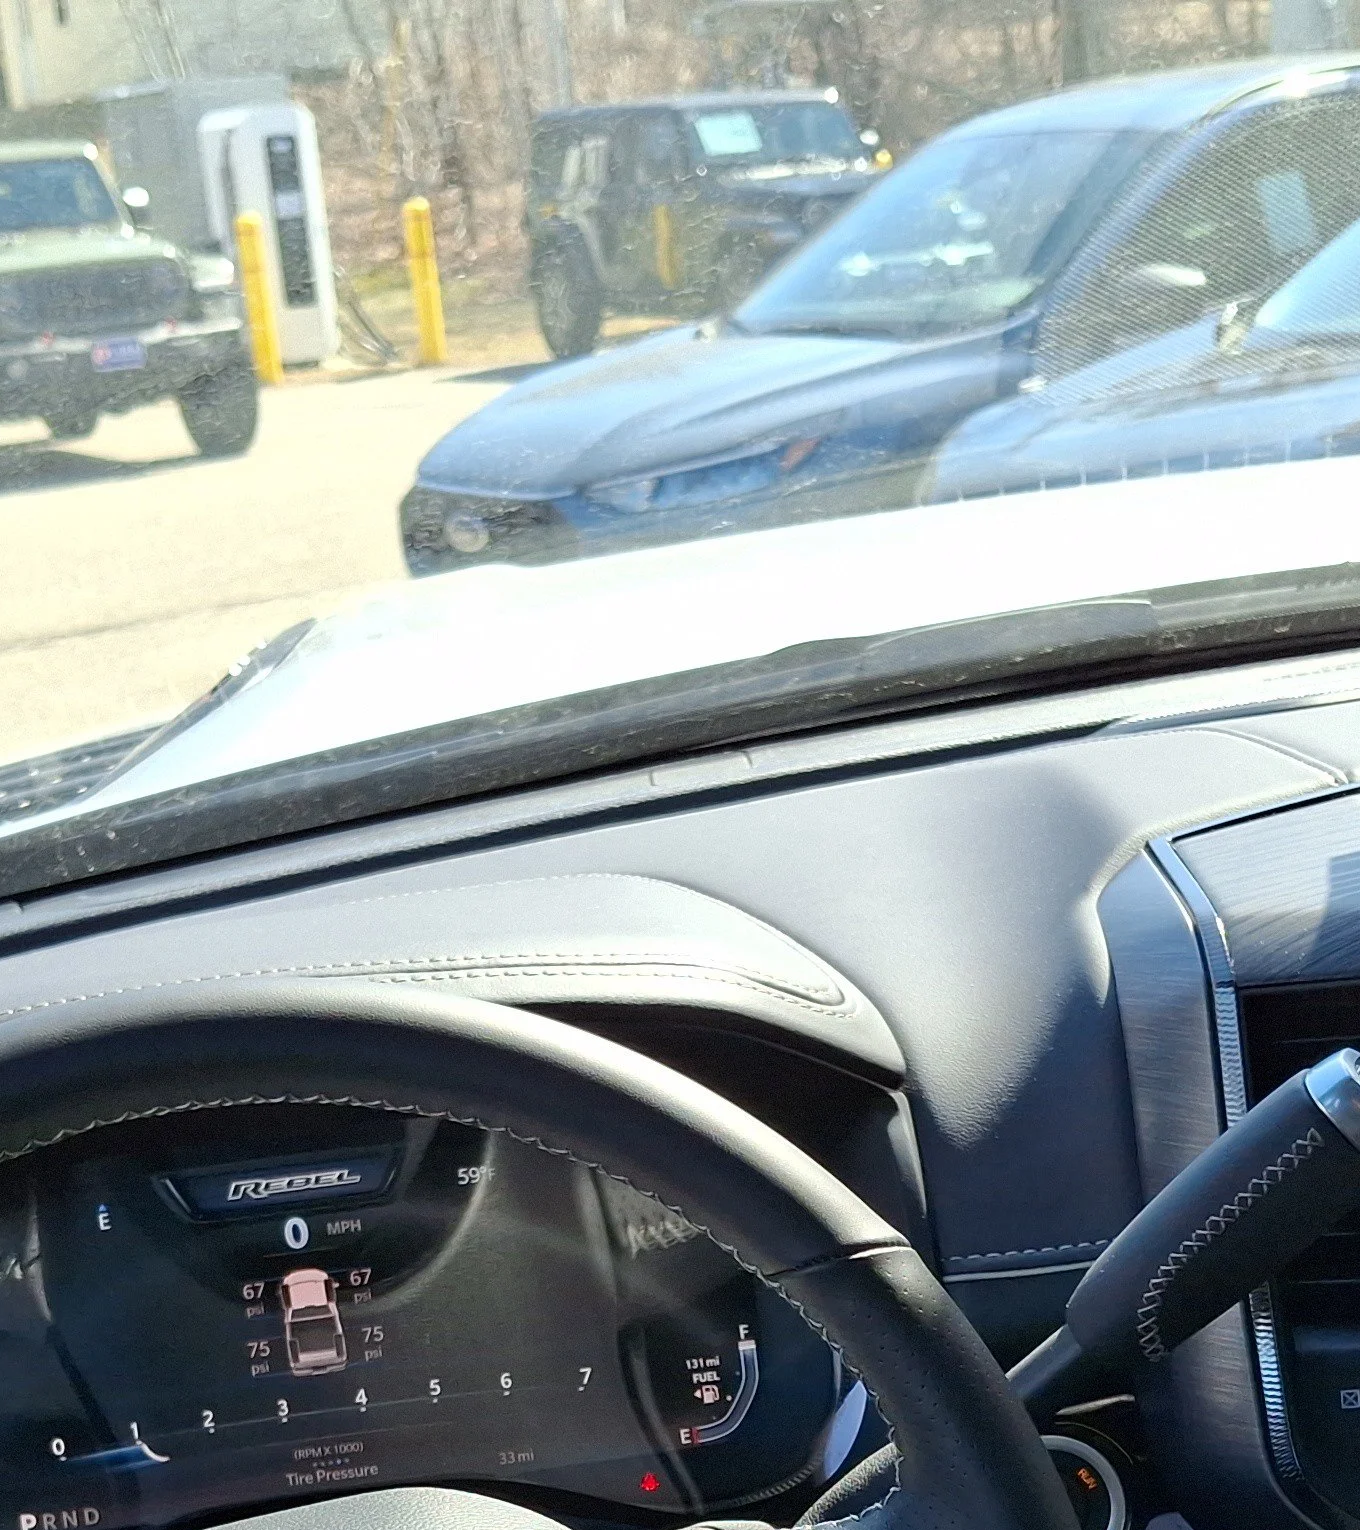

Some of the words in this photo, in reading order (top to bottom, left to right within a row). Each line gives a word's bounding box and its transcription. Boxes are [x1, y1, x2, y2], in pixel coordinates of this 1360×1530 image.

[227, 1169, 362, 1202] REBEL
[98, 1212, 112, 1232] E
[284, 1217, 309, 1250] 0
[326, 1219, 362, 1236] MPH
[350, 1269, 372, 1288] 67
[242, 1282, 265, 1301] 67
[354, 1288, 372, 1304] psi
[246, 1304, 265, 1319] psi
[362, 1326, 384, 1343] 75
[739, 1325, 749, 1339] F
[247, 1342, 271, 1359] 75
[365, 1346, 383, 1361] psi
[251, 1361, 270, 1377] psi
[686, 1357, 702, 1370] 131
[703, 1355, 720, 1368] mi
[500, 1372, 512, 1390] 6
[580, 1368, 592, 1386] 7
[693, 1370, 720, 1383] FUEL
[429, 1379, 441, 1397] 5
[355, 1389, 368, 1407] 4
[277, 1400, 289, 1418] 3
[202, 1410, 215, 1428] 2
[130, 1422, 140, 1441] 1
[680, 1428, 691, 1444] E
[51, 1438, 66, 1458] 0
[499, 1451, 516, 1465] 33
[518, 1449, 535, 1464] mi
[286, 1471, 313, 1487] Tire
[315, 1464, 379, 1485] Pressure
